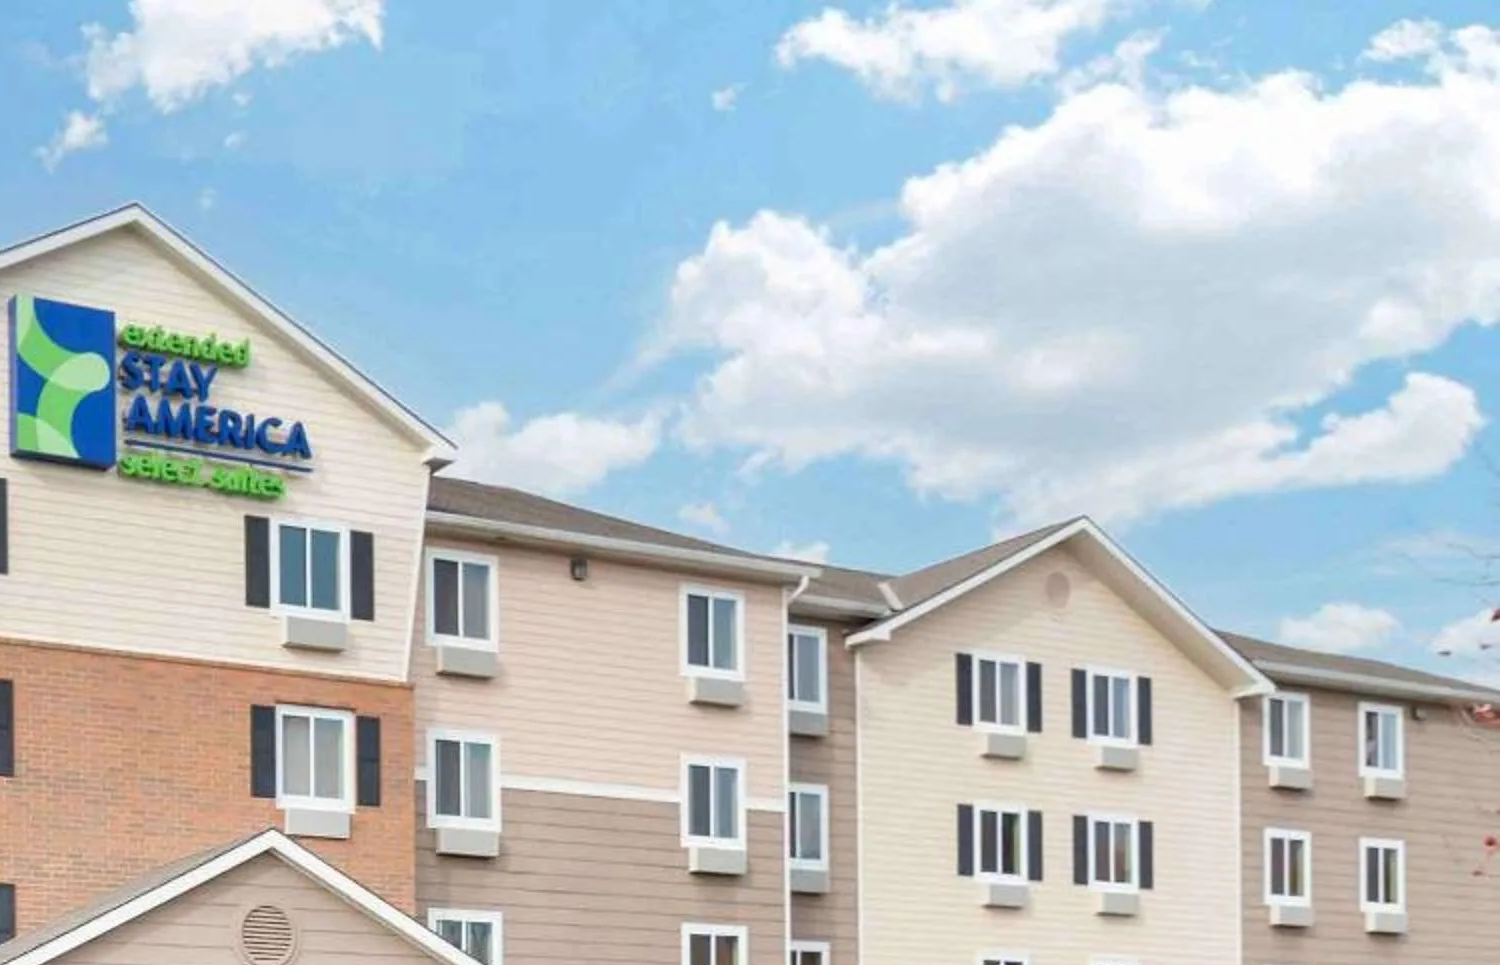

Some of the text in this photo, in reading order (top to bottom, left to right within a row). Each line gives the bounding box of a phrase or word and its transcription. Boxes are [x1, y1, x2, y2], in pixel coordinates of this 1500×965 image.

[122, 324, 250, 366] extended
[121, 351, 217, 402] STAY
[126, 395, 311, 458] AMERICA
[212, 465, 285, 499] suites
